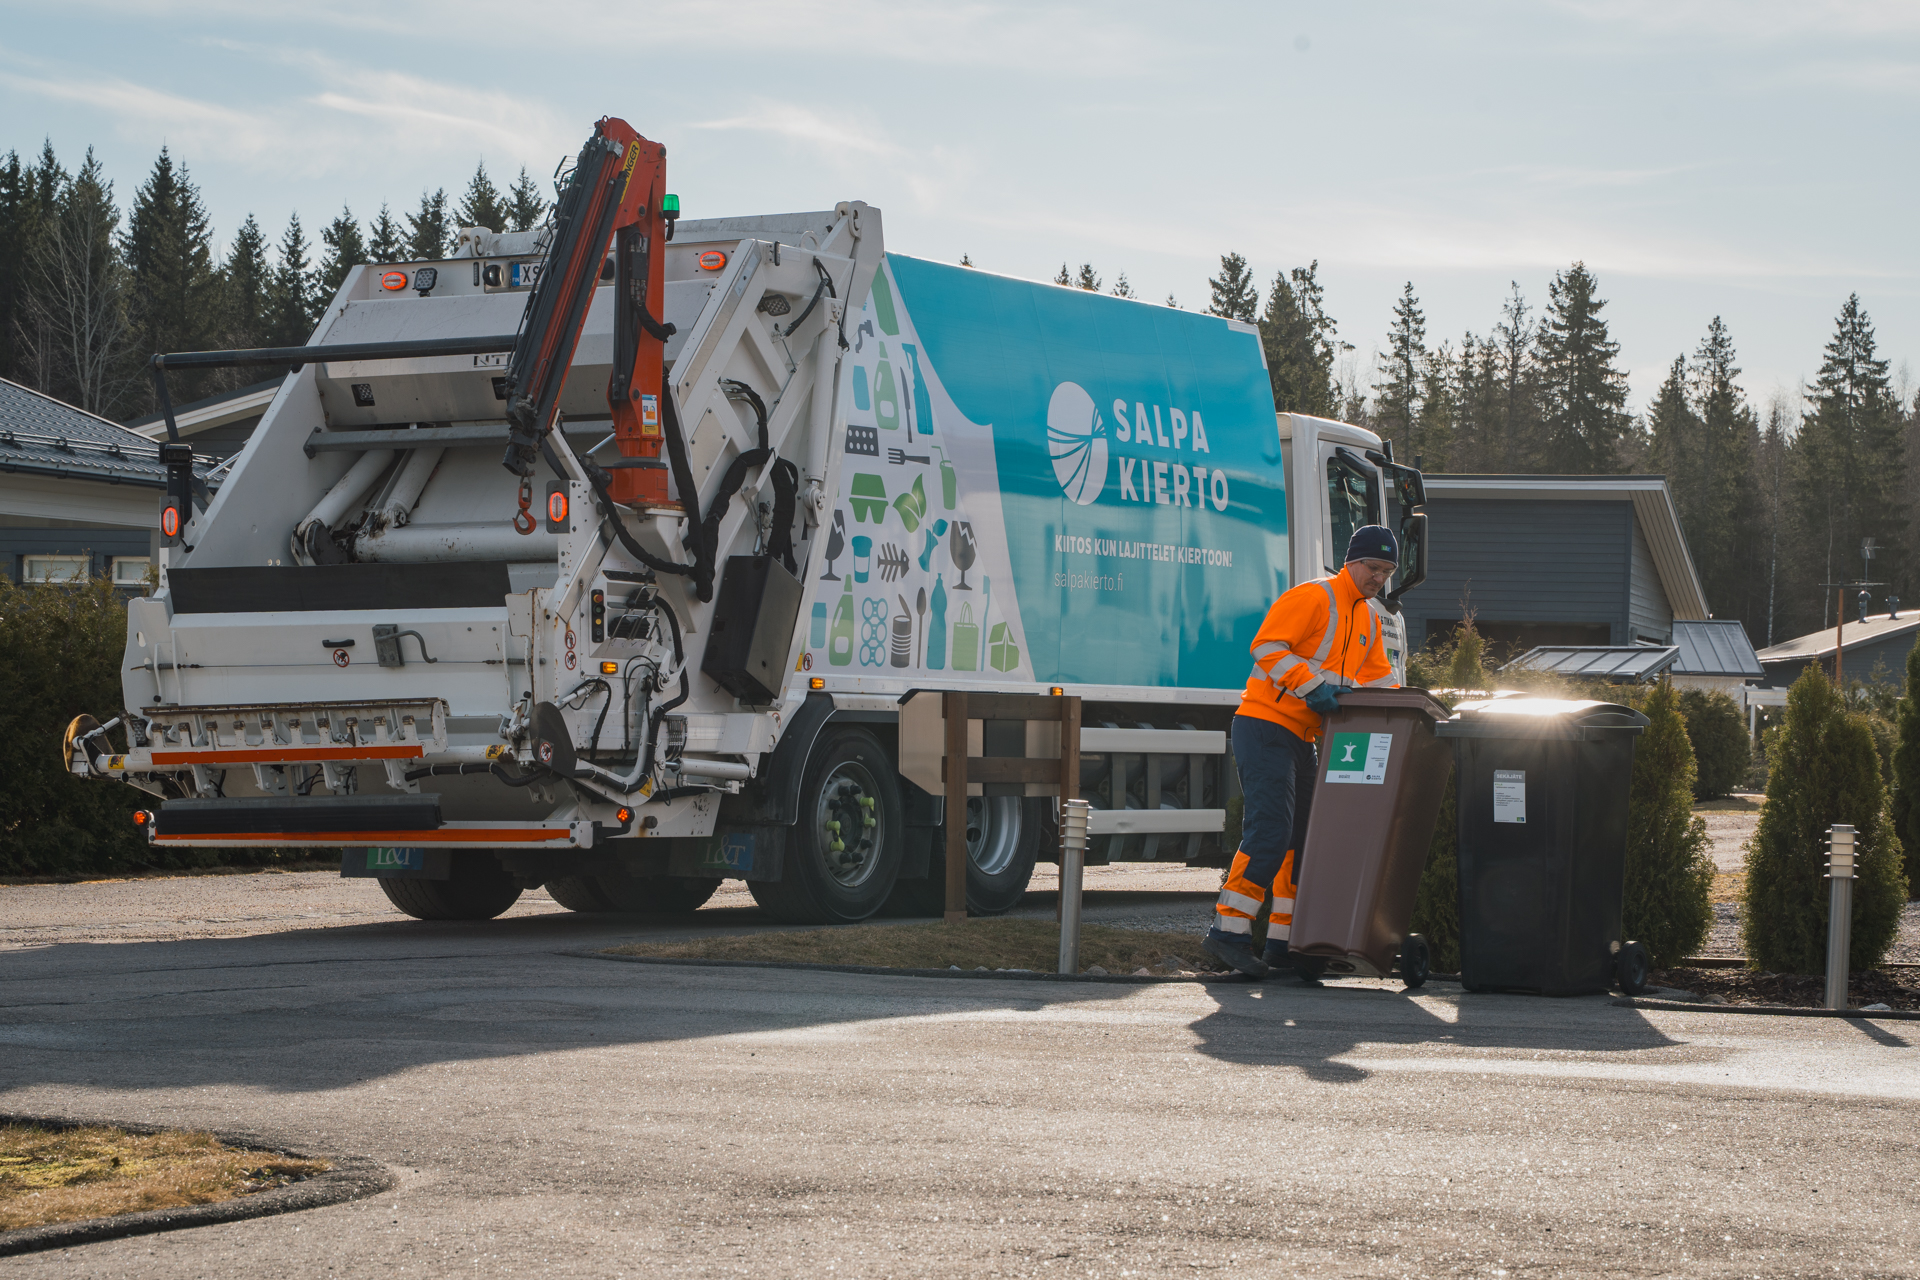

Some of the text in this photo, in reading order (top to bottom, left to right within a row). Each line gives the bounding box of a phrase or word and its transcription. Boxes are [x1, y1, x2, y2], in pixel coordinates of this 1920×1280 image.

[624, 144, 639, 178] INGER
[1113, 398, 1210, 454] SALPA
[1118, 456, 1229, 512] KIERTO
[1055, 534, 1233, 568] KIITOS KUN LAJITTELET KIERTOON!
[1054, 568, 1124, 592] salpakierto.fi
[703, 835, 746, 866] L&T
